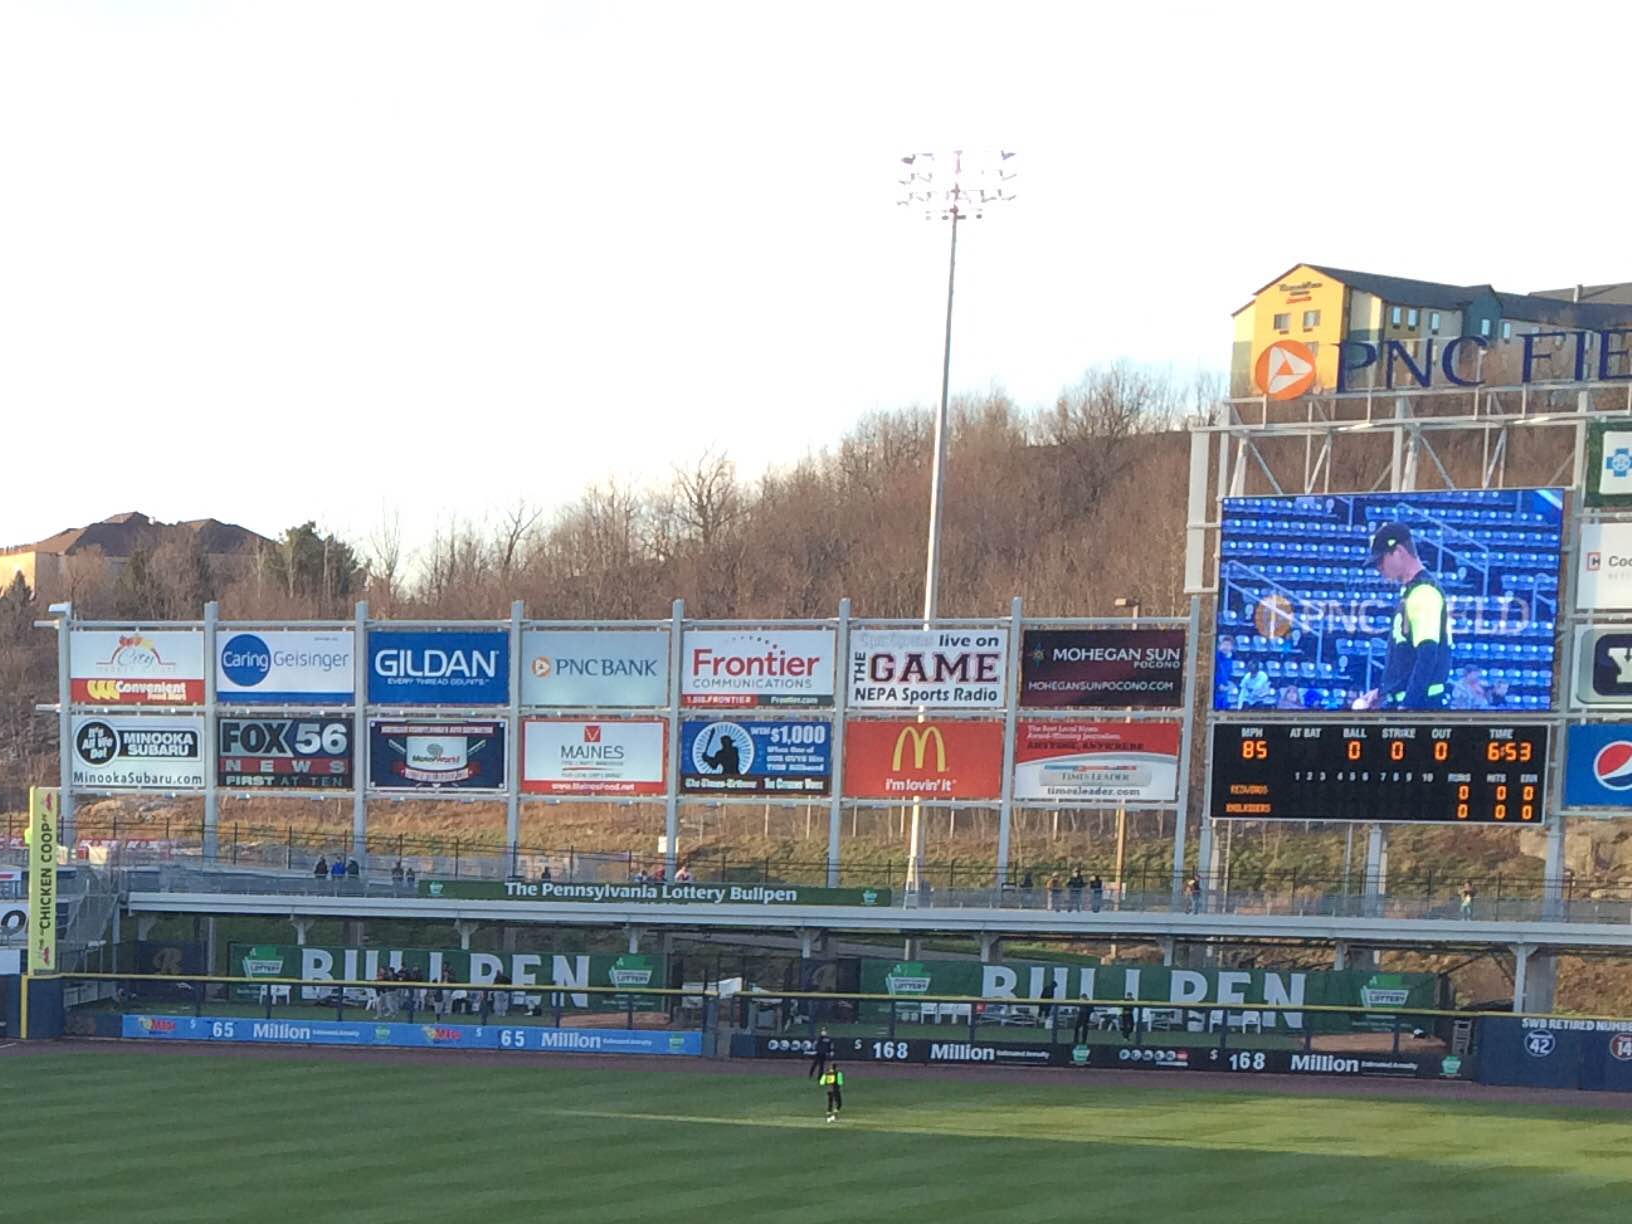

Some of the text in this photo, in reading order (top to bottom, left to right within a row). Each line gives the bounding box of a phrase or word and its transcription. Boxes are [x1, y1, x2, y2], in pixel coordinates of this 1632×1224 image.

[1333, 335, 1489, 393] PNC
[939, 634, 971, 647] live
[976, 636, 999, 647] on
[223, 650, 349, 672] Caring Geisinger
[693, 648, 820, 677] Frontier
[1053, 648, 1180, 662] MOHEGAN SUN
[375, 649, 496, 678] GILDAN
[854, 651, 866, 684] THE
[869, 652, 1000, 684] GAME
[1134, 660, 1180, 669] POCONO
[116, 681, 186, 693] Convenient
[692, 678, 813, 689] COMMUNICATIONS
[855, 686, 998, 704] NEPA Sports Radio
[124, 733, 194, 745] MINOOKA
[222, 722, 348, 755] FOX 56
[770, 725, 826, 745] $1,000
[1241, 728, 1513, 739] MPH AT BAT BALL STRIKE OUT TIME
[128, 744, 189, 756] SUBARU
[560, 745, 624, 759] MAINES
[1242, 741, 1532, 761] 85 0 0 0 6:53
[224, 760, 345, 773] NEWS
[73, 771, 202, 784] MinookaSubaru.com
[226, 776, 343, 786] FIRST AT TEN
[941, 779, 951, 791] it
[1048, 787, 1140, 796] timesleader.com
[1458, 785, 1534, 801] 0 0 0
[1457, 804, 1532, 820] 0 0 0
[504, 881, 797, 905] The Pennsylvania Lottery Bullpen
[213, 1022, 235, 1038] 65
[254, 1023, 311, 1040] Million
[1549, 1019, 1595, 1031] RETIRED
[500, 1030, 525, 1048] 65
[541, 1032, 600, 1049] Million
[1529, 1038, 1550, 1055] 42
[873, 1042, 909, 1060] 168
[930, 1044, 995, 1061] Million
[1229, 1053, 1265, 1071] 168
[1290, 1054, 1359, 1073] Million
